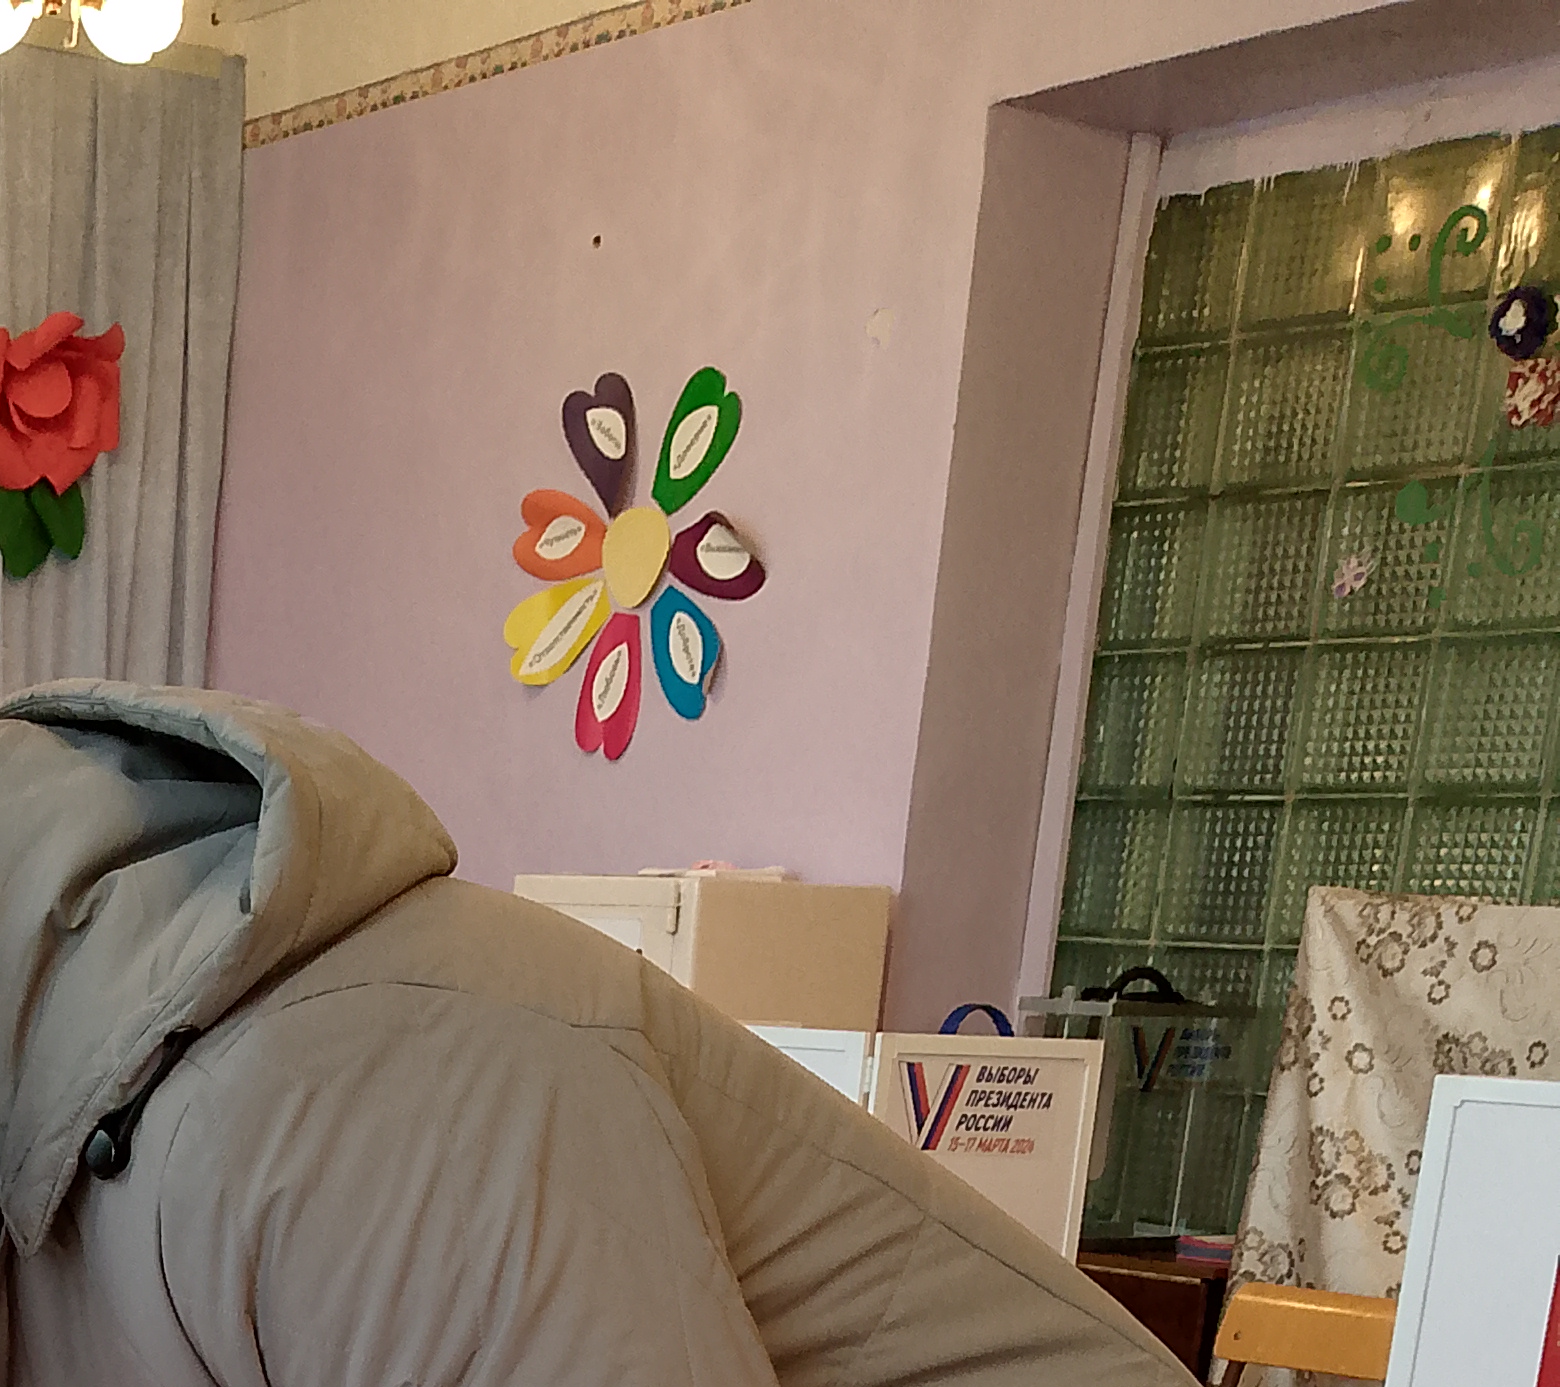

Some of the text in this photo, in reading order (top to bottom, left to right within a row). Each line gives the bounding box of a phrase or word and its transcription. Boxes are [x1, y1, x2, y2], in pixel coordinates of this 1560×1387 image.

[976, 1065, 1040, 1085] ВЫБОРЫ
[965, 1089, 1054, 1111] ПРЕЗИДЕНТА
[955, 1113, 1014, 1132] РОССИИ
